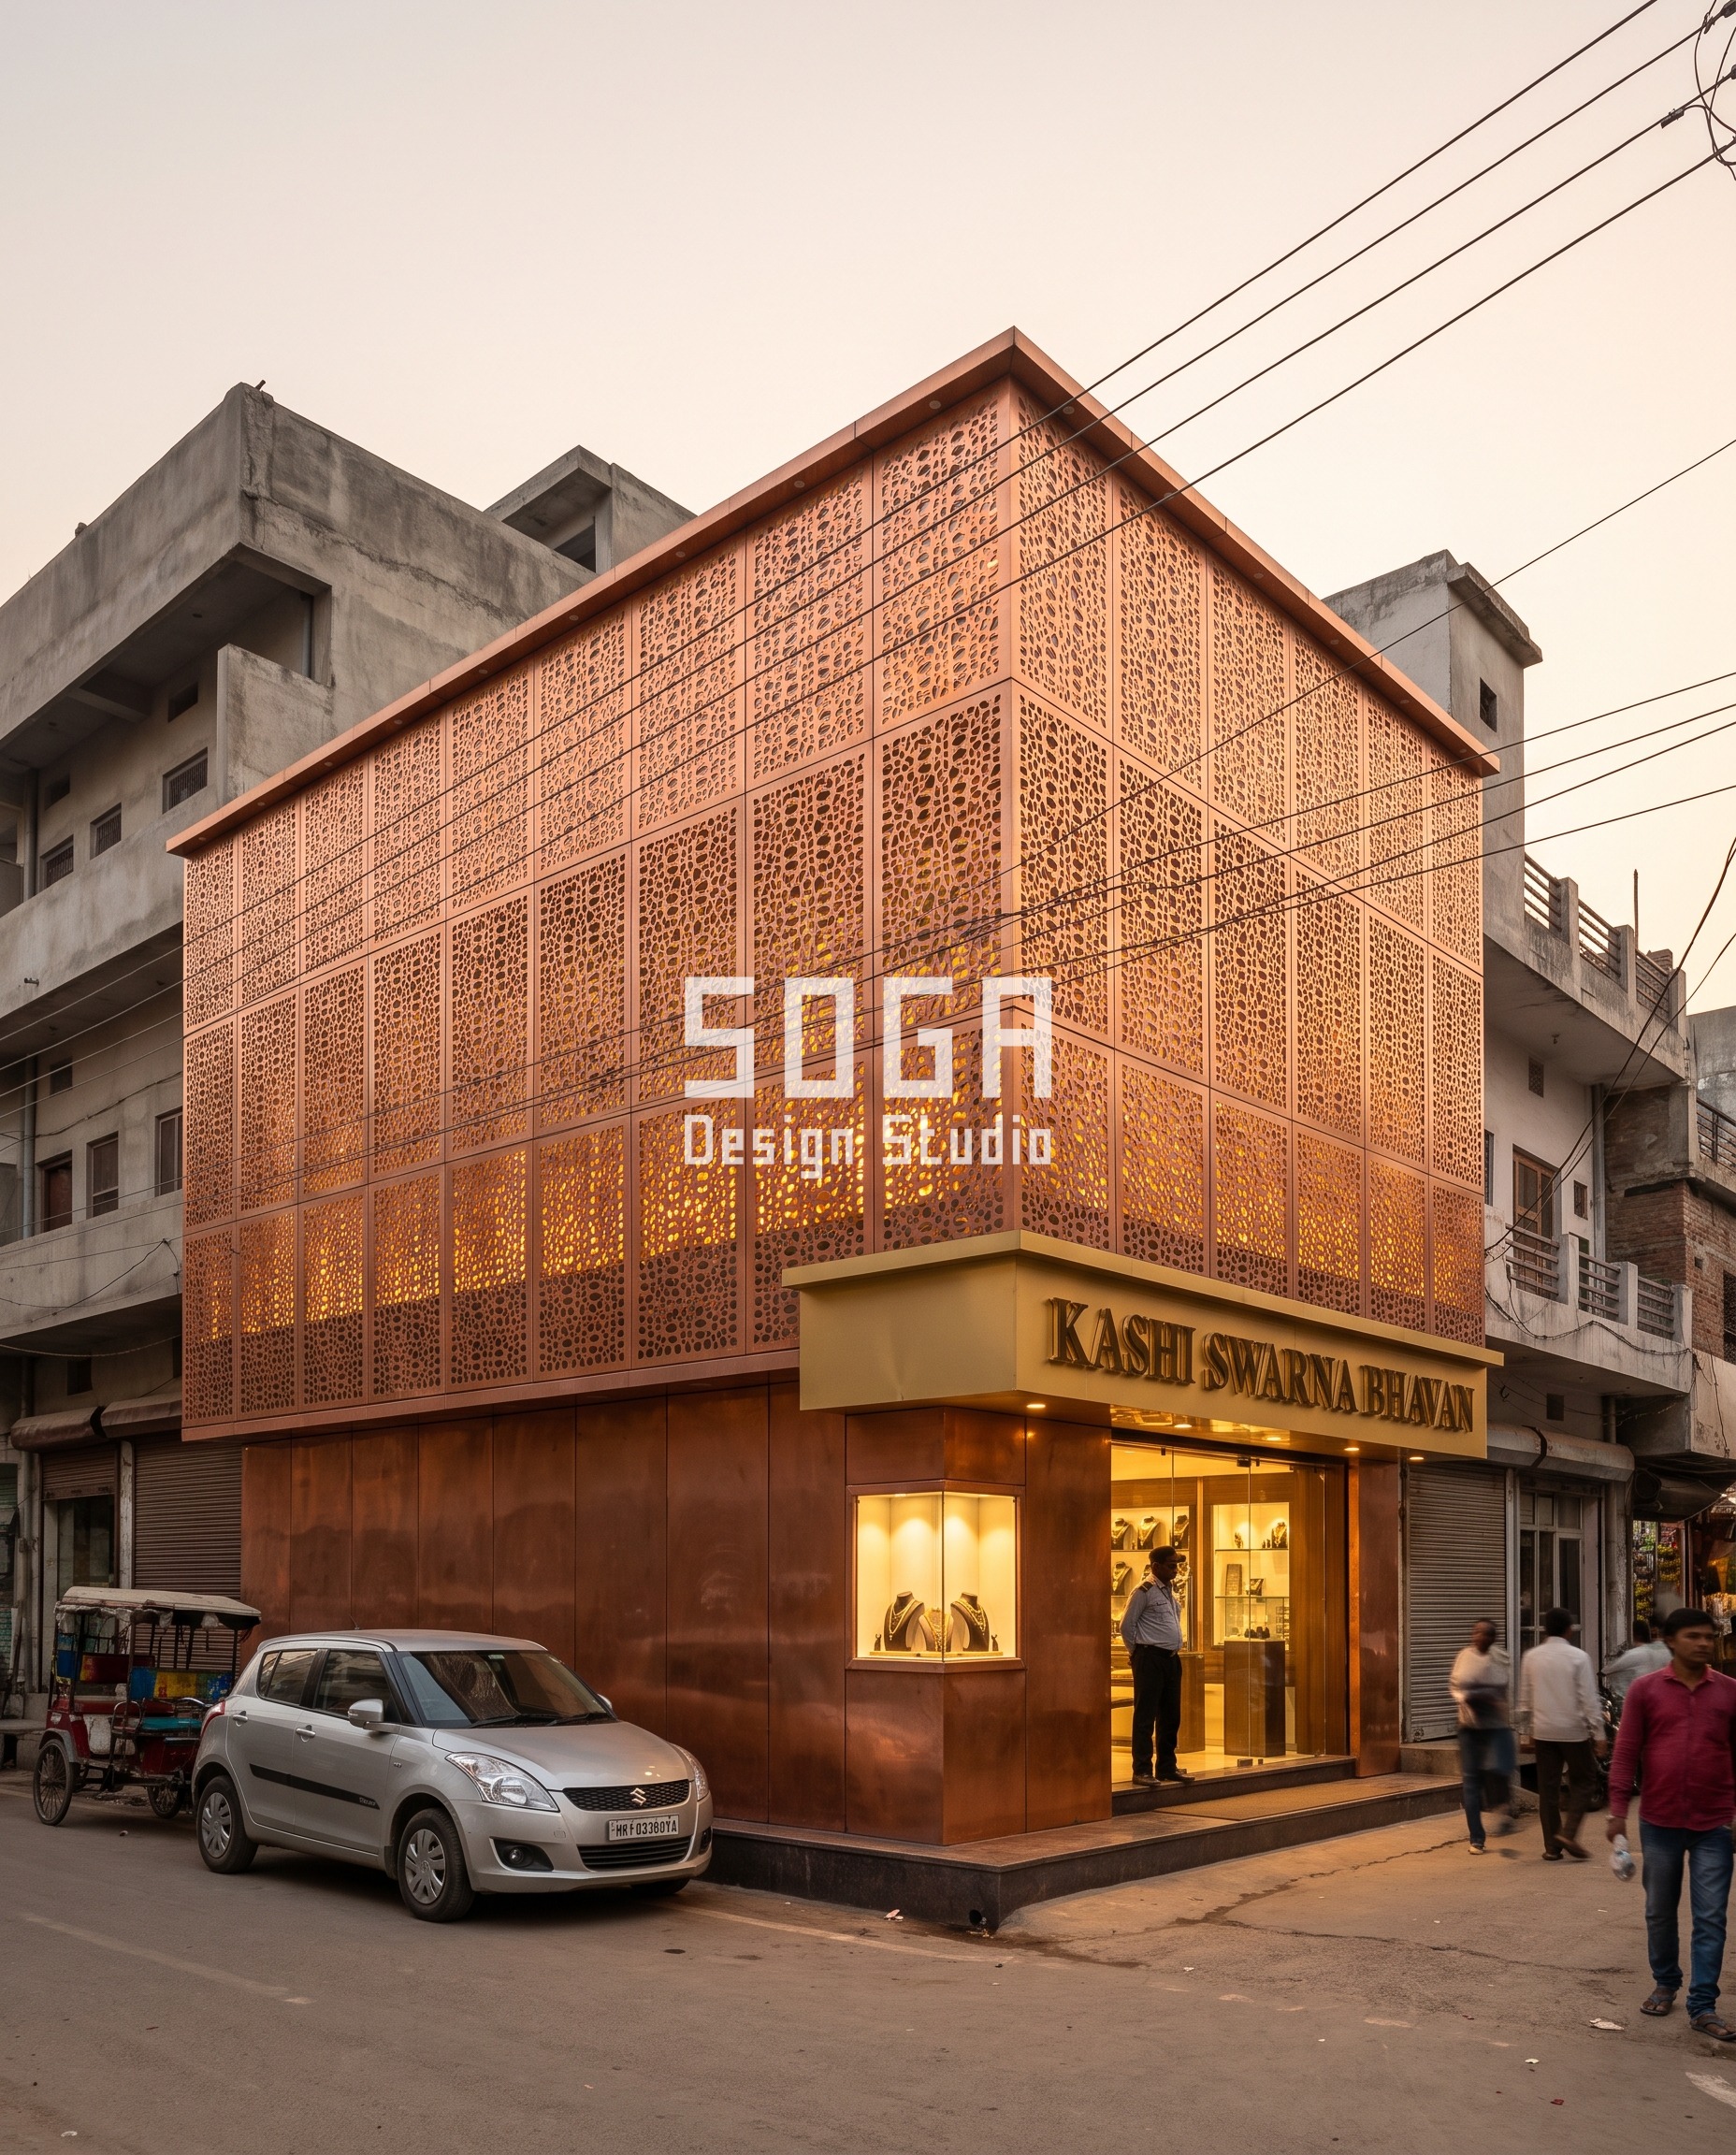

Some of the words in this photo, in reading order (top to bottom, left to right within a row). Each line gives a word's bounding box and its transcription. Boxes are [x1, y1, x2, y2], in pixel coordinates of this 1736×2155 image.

[1048, 1297, 1196, 1384] KASHI
[1203, 1332, 1358, 1413] SWARNA
[1360, 1365, 1475, 1432] BHAVAN
